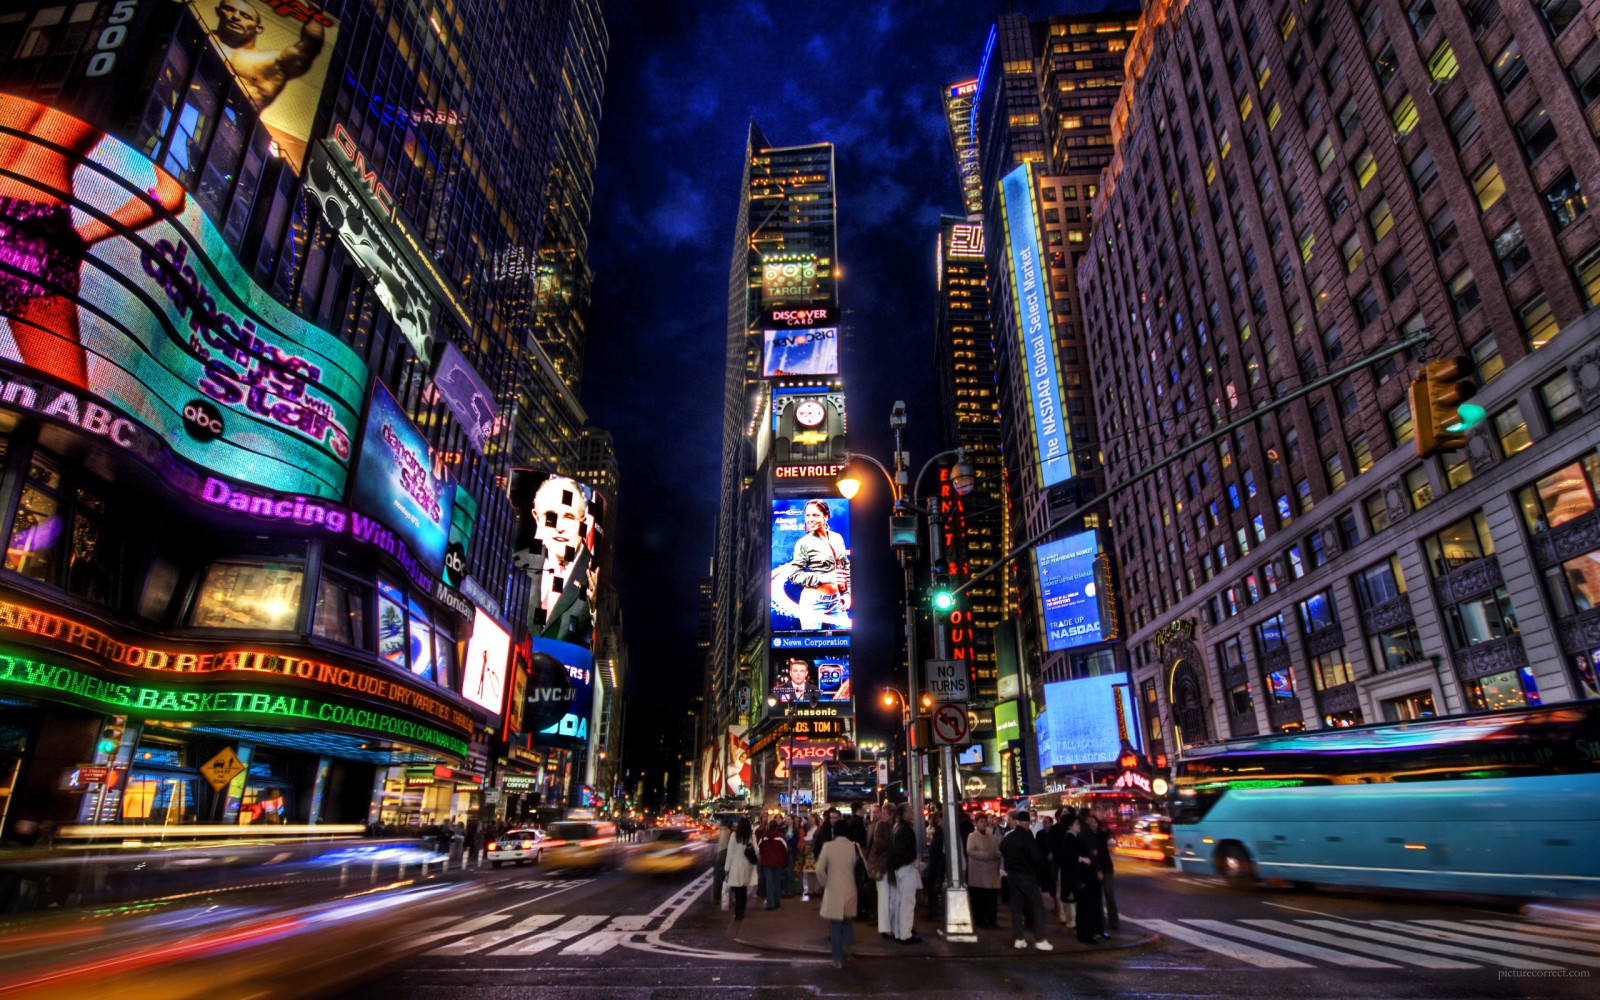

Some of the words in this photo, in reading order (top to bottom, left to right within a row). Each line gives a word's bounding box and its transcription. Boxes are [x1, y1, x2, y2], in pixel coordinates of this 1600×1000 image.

[87, 0, 137, 77] 500
[325, 160, 337, 176] THE
[336, 174, 349, 196] NEW
[347, 191, 360, 210] 2007
[334, 122, 392, 217] GMC
[362, 208, 396, 259] YUKON
[396, 257, 431, 306] DENALI
[395, 217, 407, 235] WE
[405, 233, 419, 252] ARE
[418, 249, 456, 305] PROFESSIONAL
[1019, 246, 1036, 293] Market
[768, 286, 812, 296] TARGET
[773, 309, 827, 321] DISCOVER
[1026, 290, 1042, 335] Select
[1031, 334, 1048, 378] Global
[0, 381, 37, 408] n
[43, 391, 137, 448] ABC
[183, 404, 223, 434] abc
[1037, 377, 1056, 436] NASDAQ
[1046, 437, 1061, 467] The
[201, 476, 347, 533] Dancing
[351, 511, 395, 554] With
[411, 562, 432, 593] Stars
[948, 561, 957, 575] &
[1074, 616, 1084, 625] UP
[804, 638, 848, 648] Corporation
[68, 624, 102, 653] PET
[103, 641, 168, 671] FOOD
[176, 651, 271, 673] RECALL
[280, 655, 314, 678] TO
[318, 665, 386, 698] INCLUDE
[388, 685, 412, 707] DRY
[821, 671, 840, 679] 80
[937, 666, 954, 677] NO
[26, 662, 131, 706] WOMEN'S
[138, 688, 309, 718] BASKETBALL
[318, 703, 377, 730] COACH
[380, 714, 416, 739] POKEY
[528, 687, 561, 703] JVC
[931, 679, 965, 692] TURNS
[784, 708, 837, 716] Pnasonic
[813, 721, 831, 733] TOM
